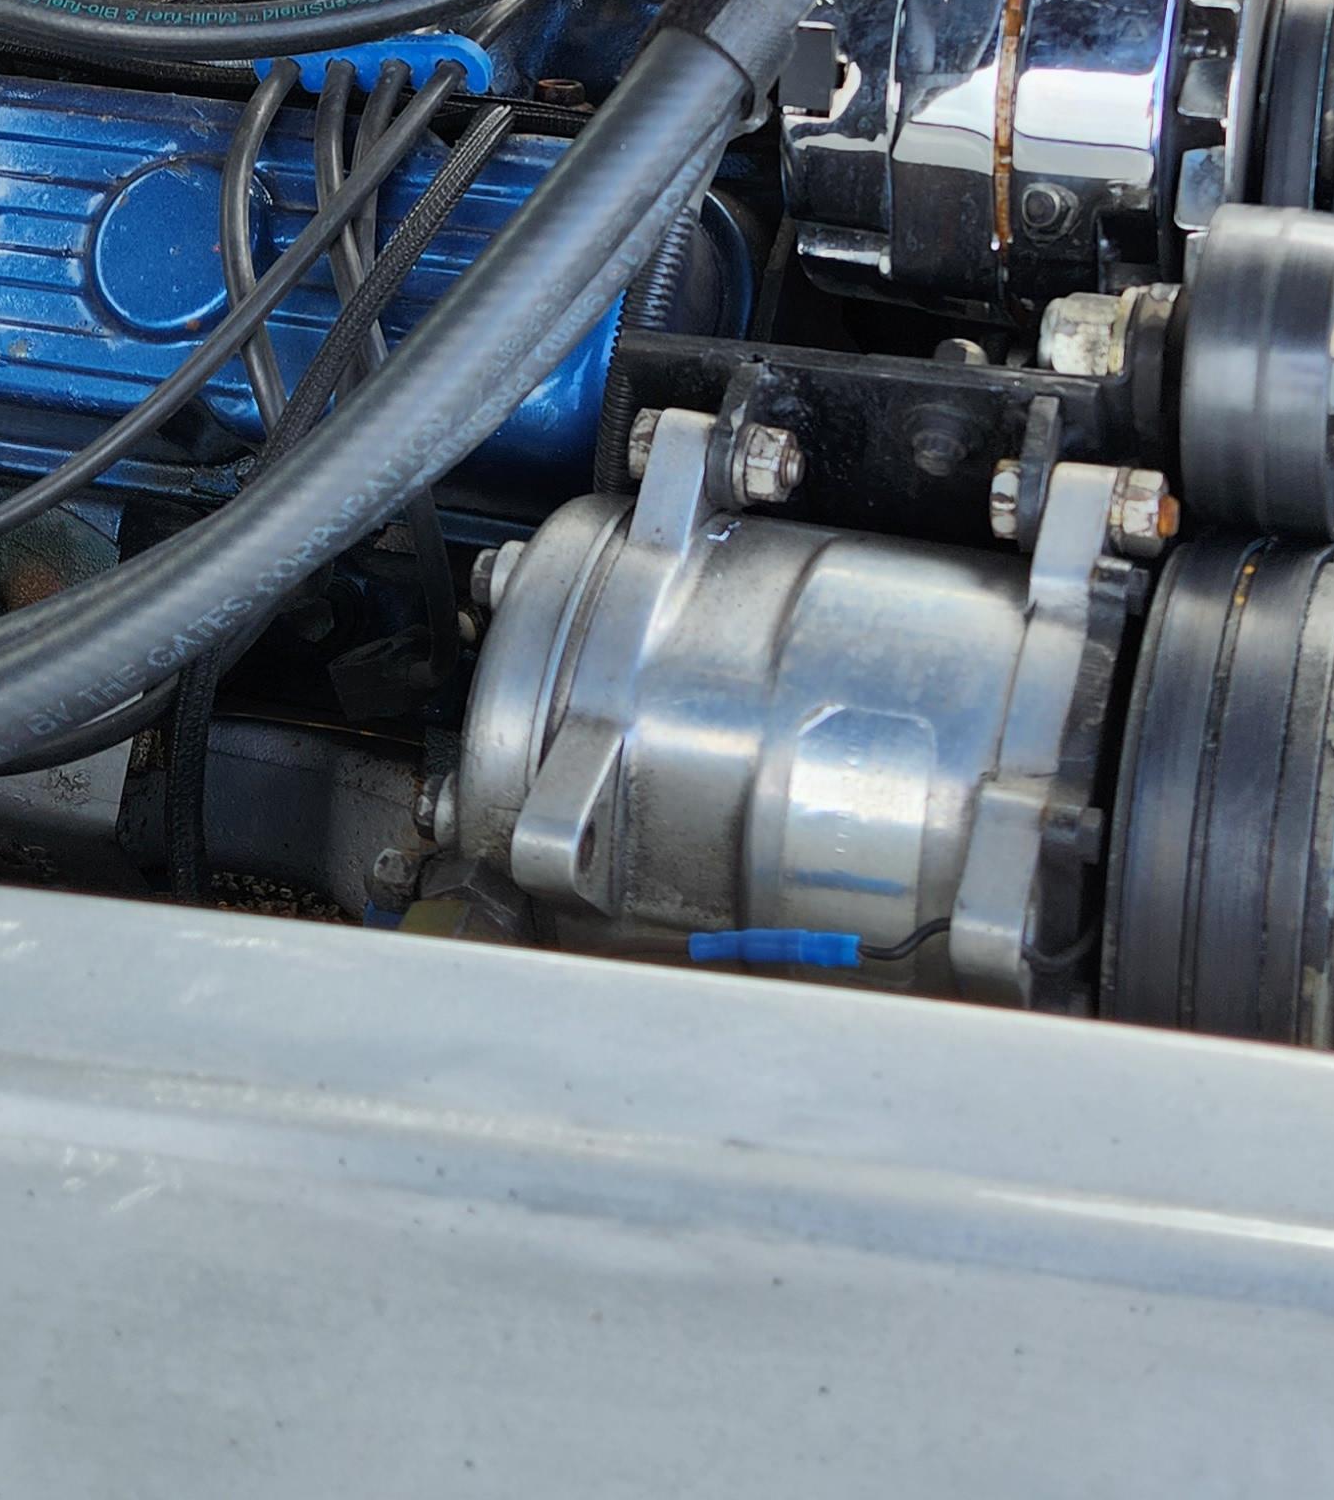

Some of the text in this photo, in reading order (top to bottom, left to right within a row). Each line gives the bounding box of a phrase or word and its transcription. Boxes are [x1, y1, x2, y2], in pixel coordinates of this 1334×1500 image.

[124, 8, 138, 20] &
[145, 10, 238, 26] Multi-fuel
[29, 702, 73, 737] BY
[78, 664, 147, 706] THE
[147, 595, 253, 670] GATES
[255, 412, 452, 597] CORPORATION
